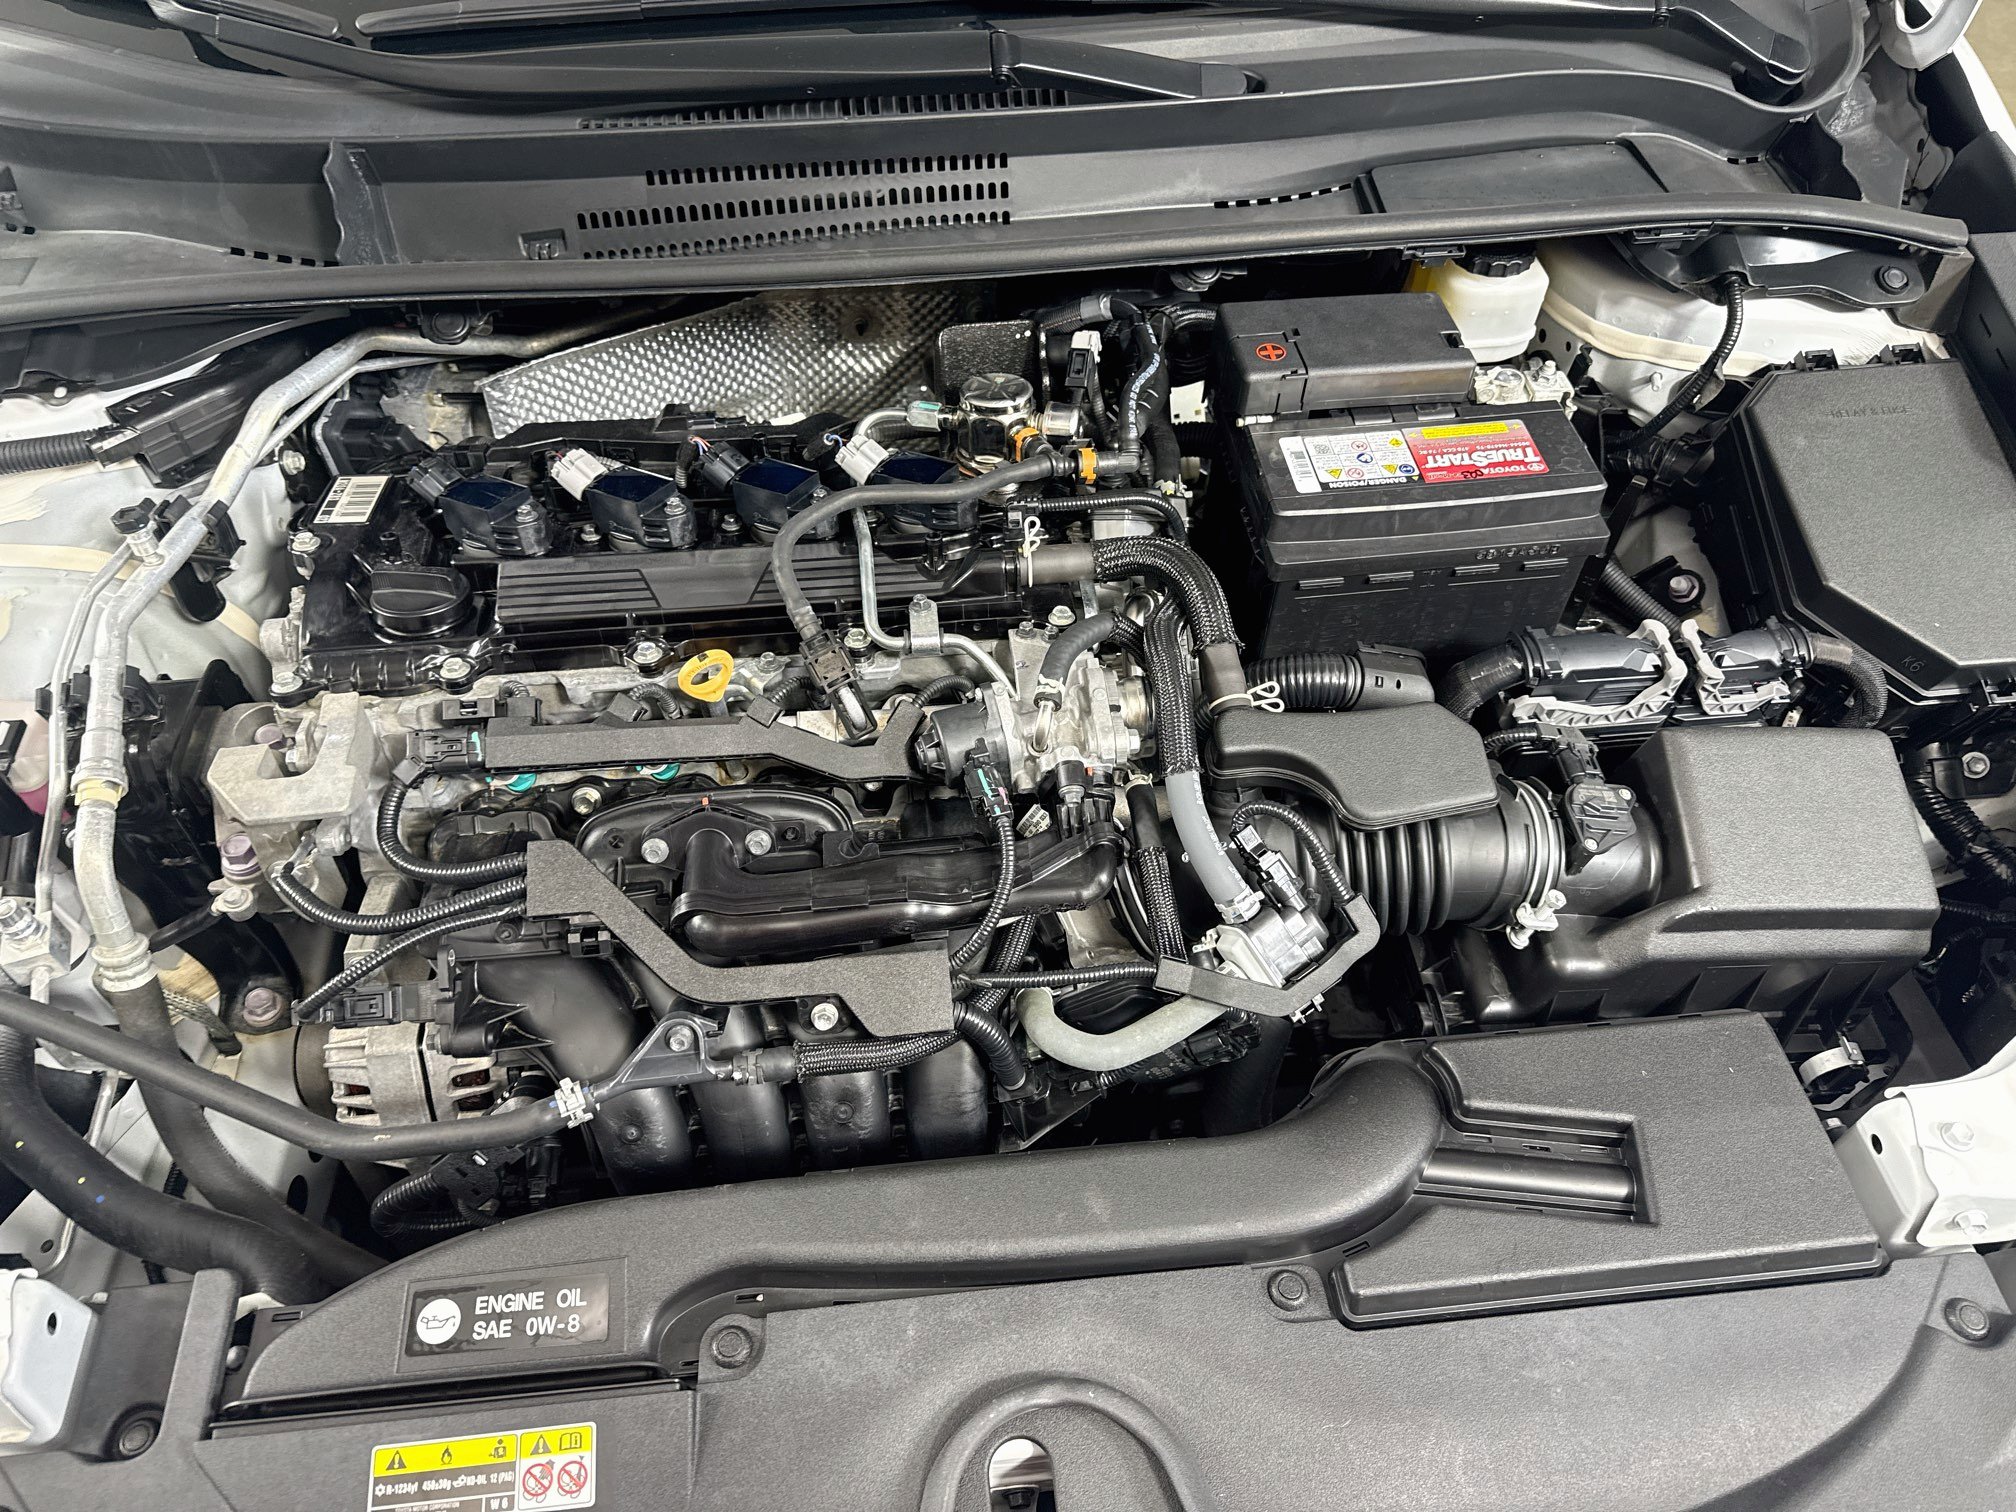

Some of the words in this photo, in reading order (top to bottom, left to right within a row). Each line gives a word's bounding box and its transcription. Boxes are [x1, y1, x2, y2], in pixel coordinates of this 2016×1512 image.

[1482, 466, 1528, 474] TOYOTA
[1329, 476, 1407, 489] DANGER/POISON
[475, 1291, 544, 1314] ENGINE
[556, 1288, 587, 1308] OIL
[472, 1319, 512, 1340] SAE
[526, 1314, 580, 1336] 0W-8
[490, 1472, 497, 1483] 12
[490, 1498, 500, 1510] W
